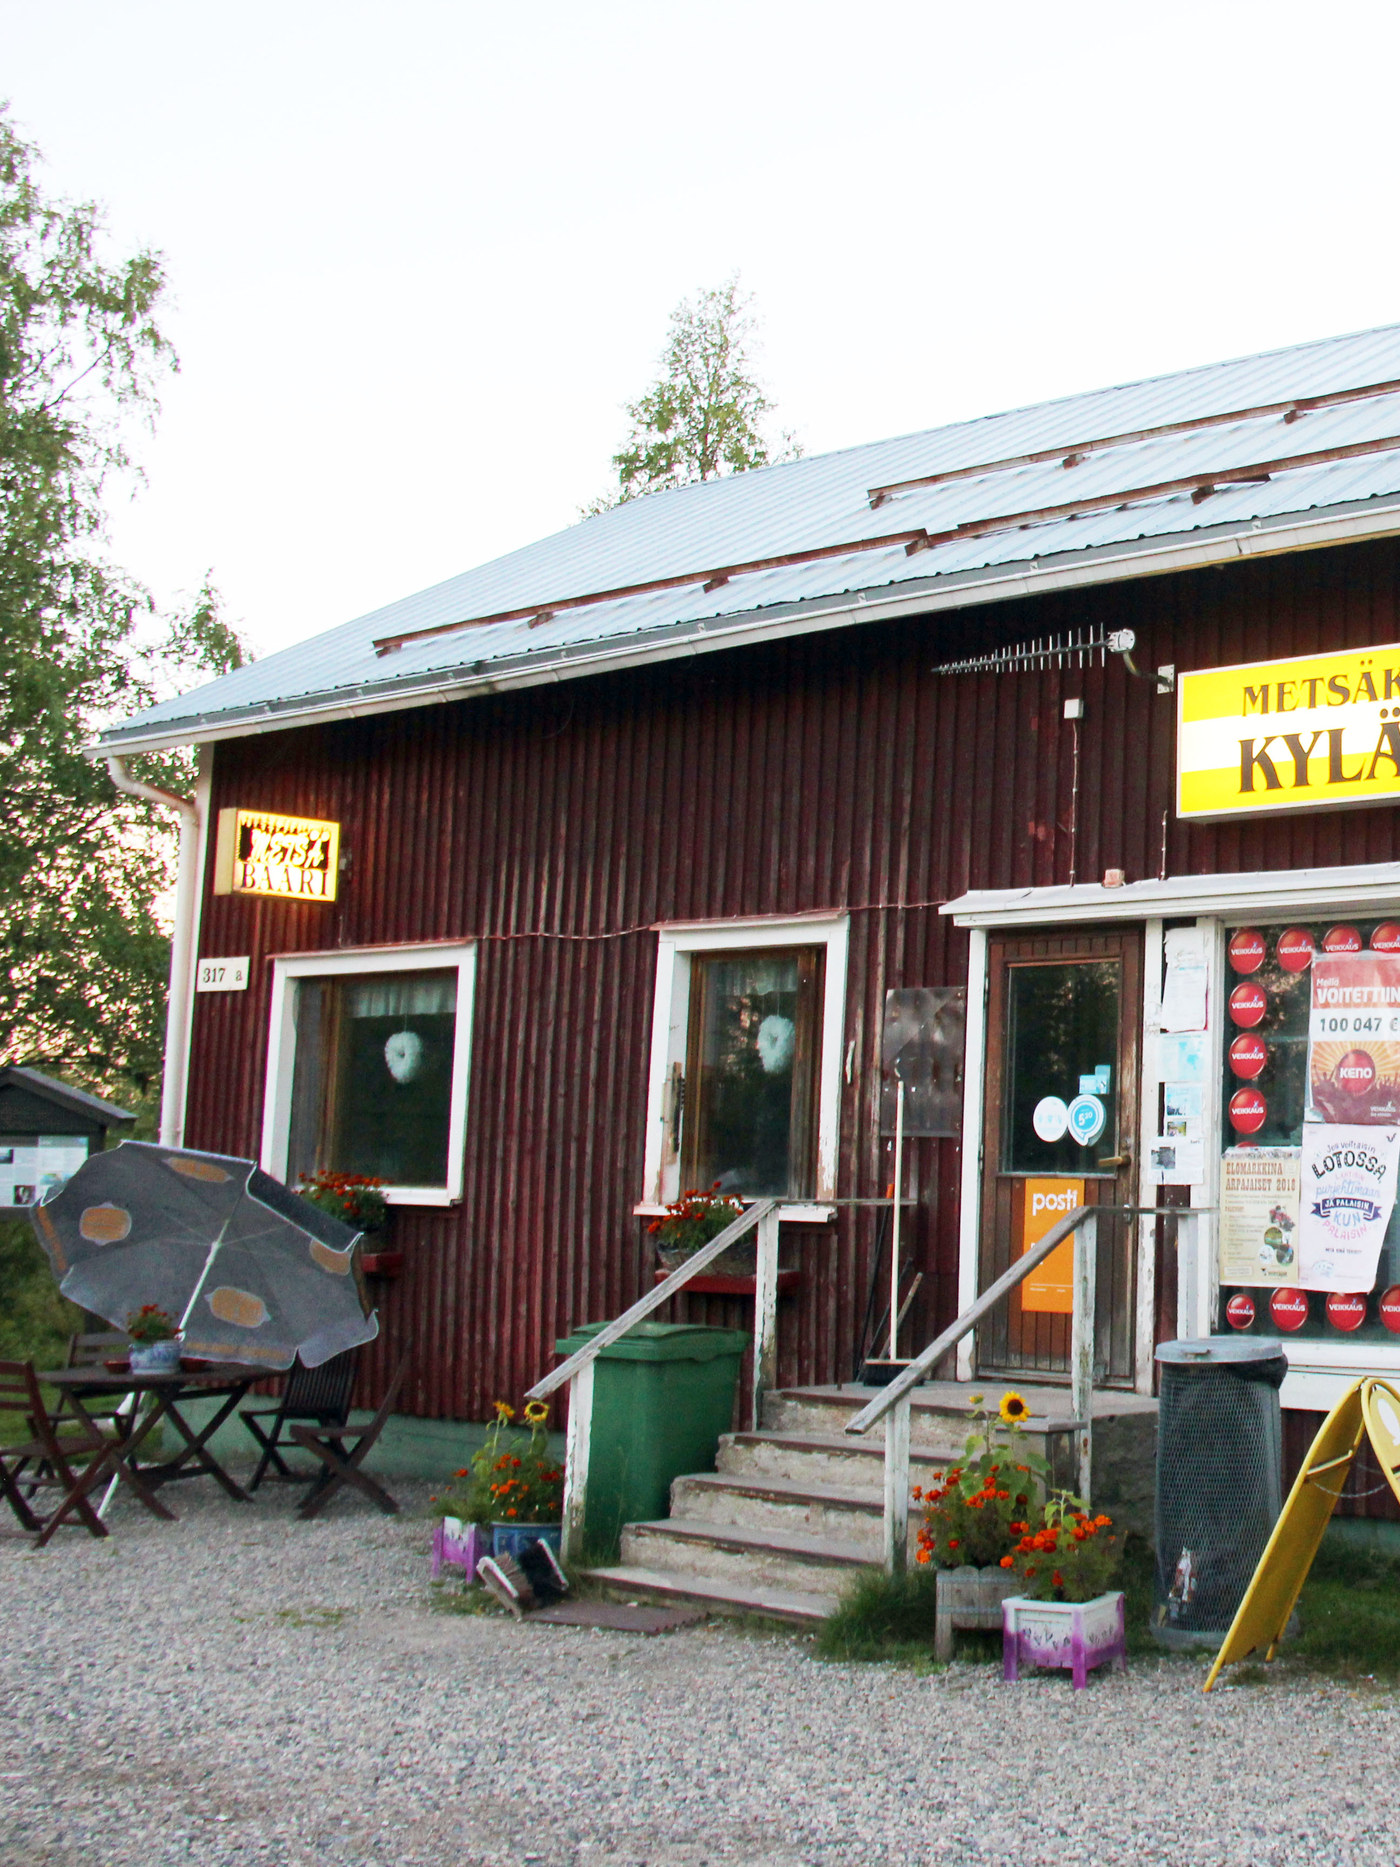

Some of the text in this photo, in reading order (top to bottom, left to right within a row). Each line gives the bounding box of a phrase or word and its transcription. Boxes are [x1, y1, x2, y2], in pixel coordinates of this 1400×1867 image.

[247, 829, 331, 868] METSÄ
[242, 863, 328, 896] BAARI
[1231, 945, 1263, 955] VEIKKAUS
[1325, 942, 1359, 952] VEIKKAUS
[203, 968, 243, 983] 317 a
[1232, 999, 1264, 1009] VEIKKAUS
[1320, 1018, 1348, 1032] 100
[1353, 1018, 1382, 1032] 047
[1232, 1051, 1264, 1060] VEIKKAUS
[1232, 1105, 1264, 1115] VEIKKAUS
[1226, 1162, 1283, 1175] ELOMARKKINA
[1226, 1179, 1296, 1191] ARPAJAISET 2018
[1032, 1189, 1077, 1216] posti
[1333, 1211, 1361, 1227] KUN
[1229, 1306, 1254, 1315] VEIKKAUS
[1272, 1301, 1306, 1311] VEIKKAUS
[1329, 1301, 1363, 1311] VEIKKAUS
